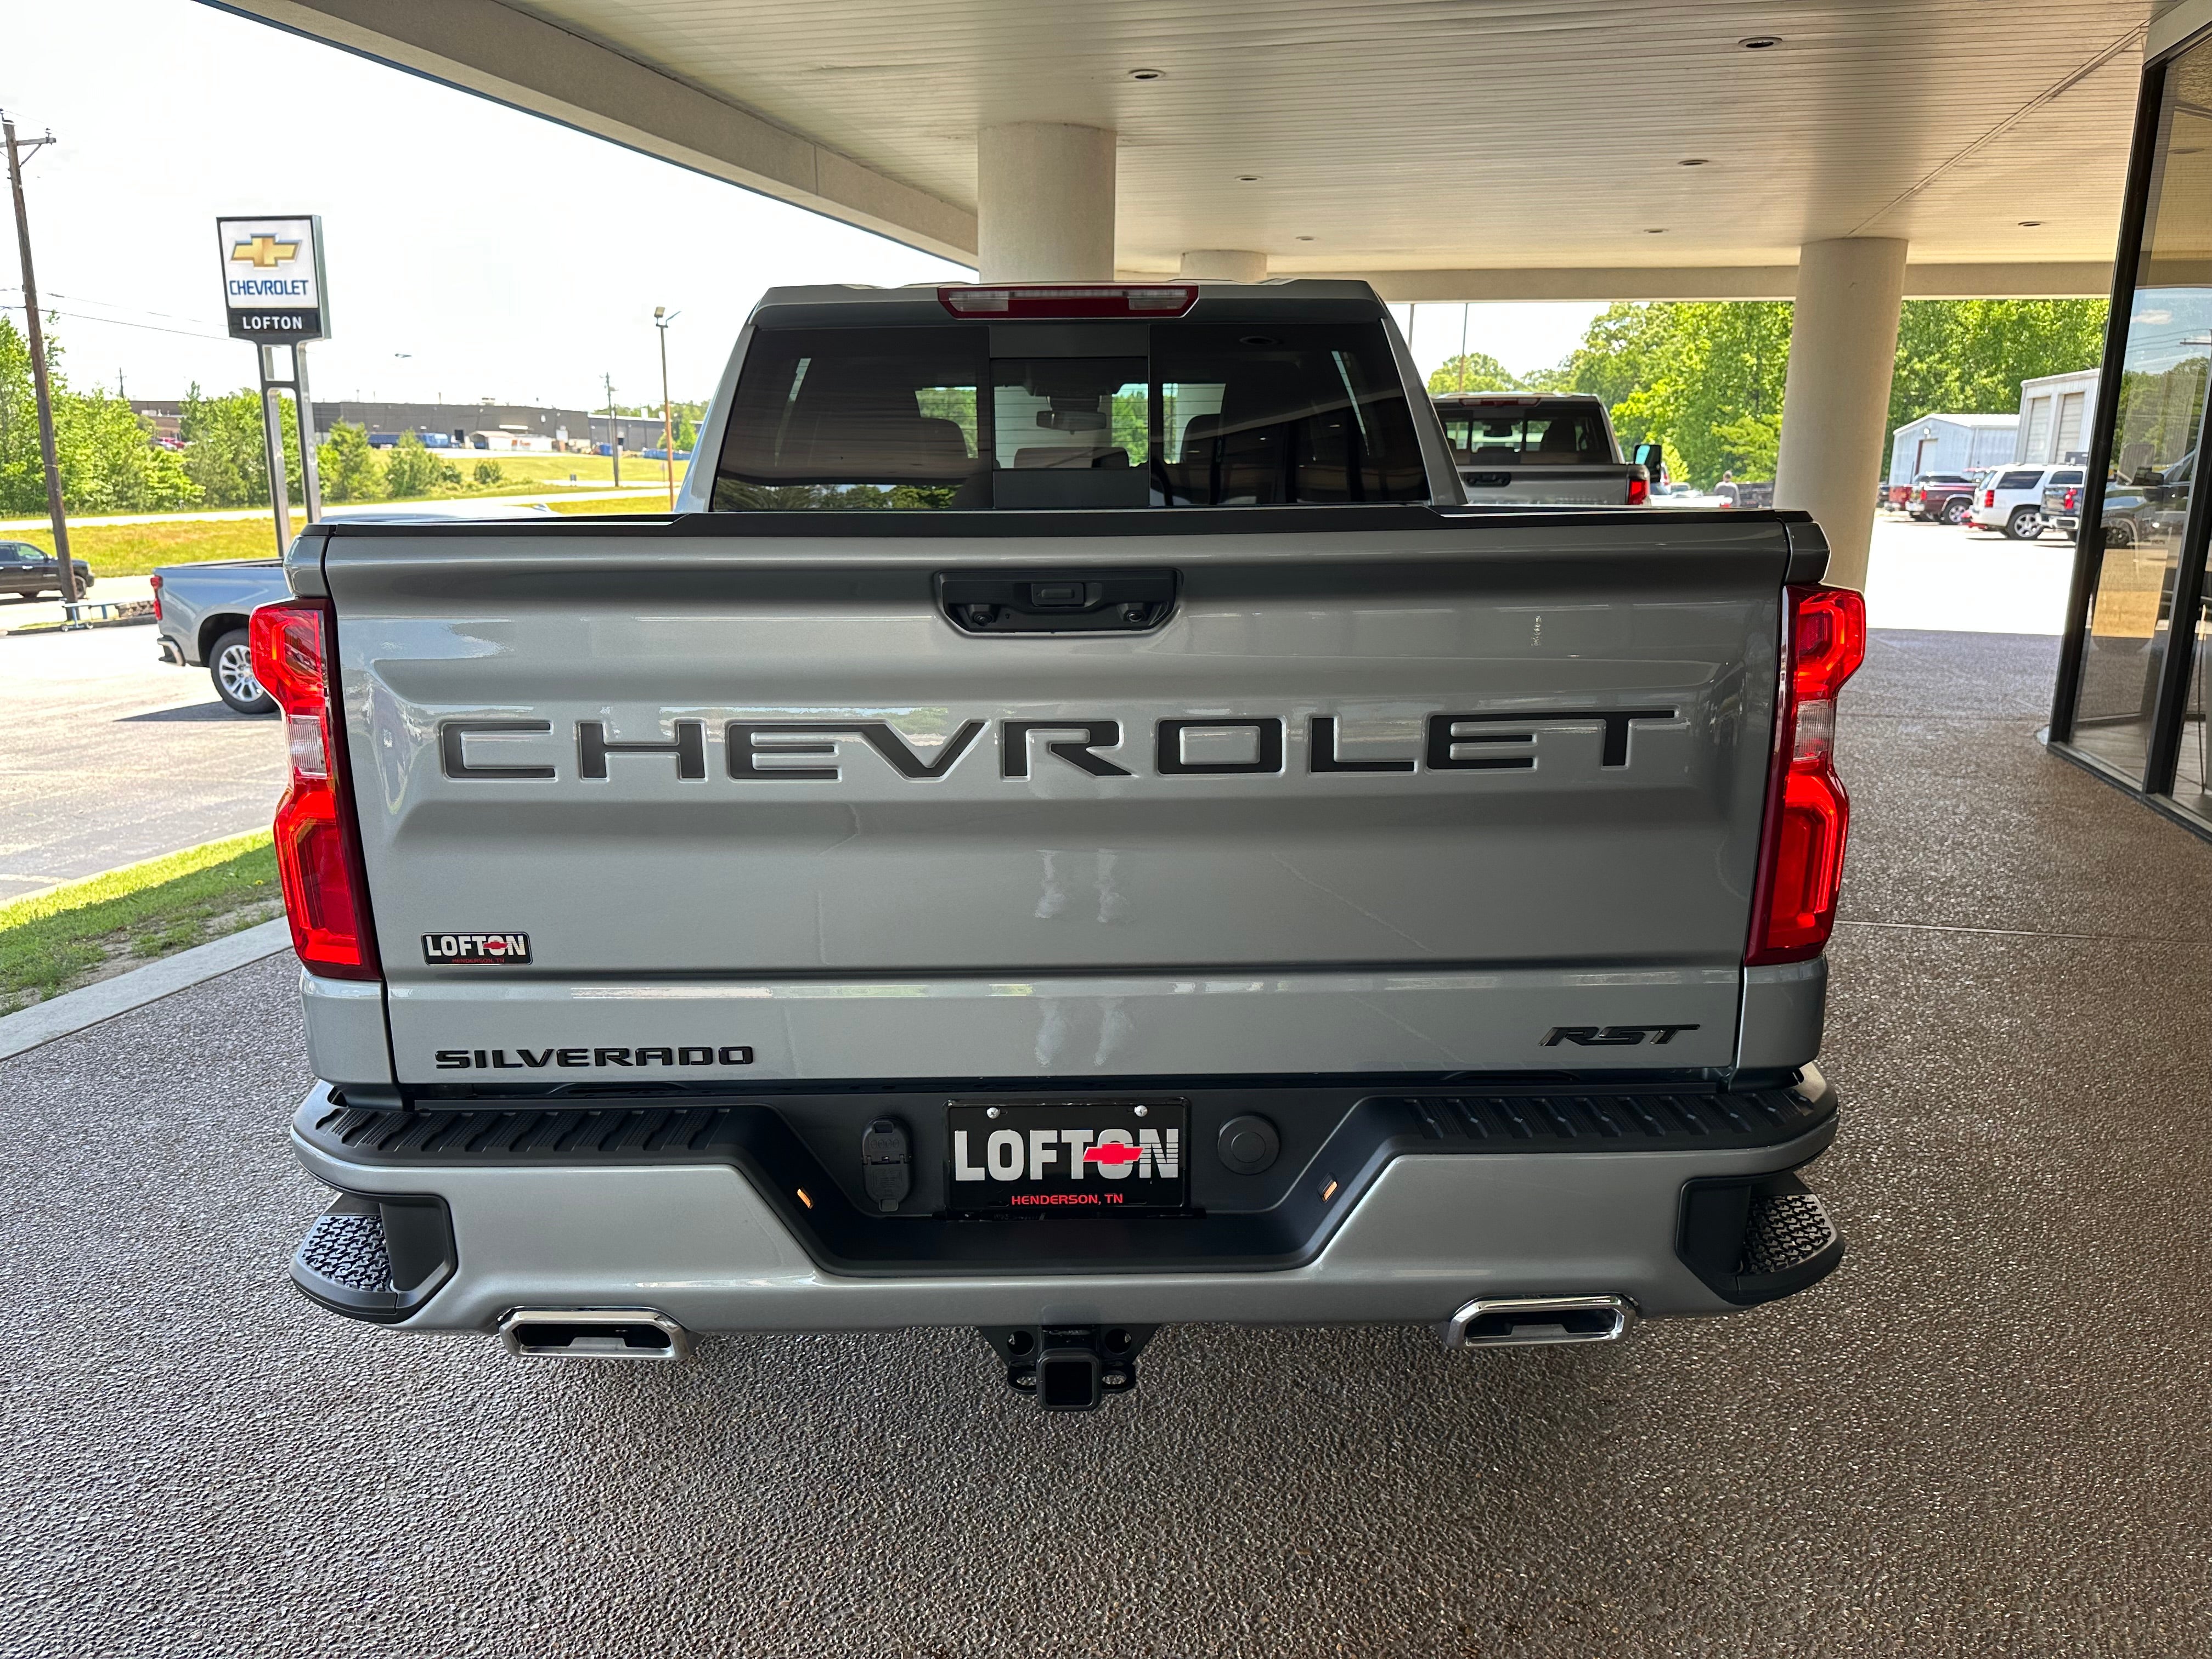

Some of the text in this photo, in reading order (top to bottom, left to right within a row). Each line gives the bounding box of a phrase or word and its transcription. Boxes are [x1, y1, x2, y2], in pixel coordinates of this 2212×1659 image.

[229, 280, 308, 295] CHEVROLET
[242, 316, 302, 330] LOFTON
[442, 706, 1677, 780] CHEVROLET
[426, 935, 526, 956] LOFTON
[1537, 1024, 1700, 1046] RST
[435, 1046, 753, 1069] SILVERADO
[955, 1128, 1178, 1181] LOFTON
[1012, 1193, 1123, 1205] HENDERSON, TN
